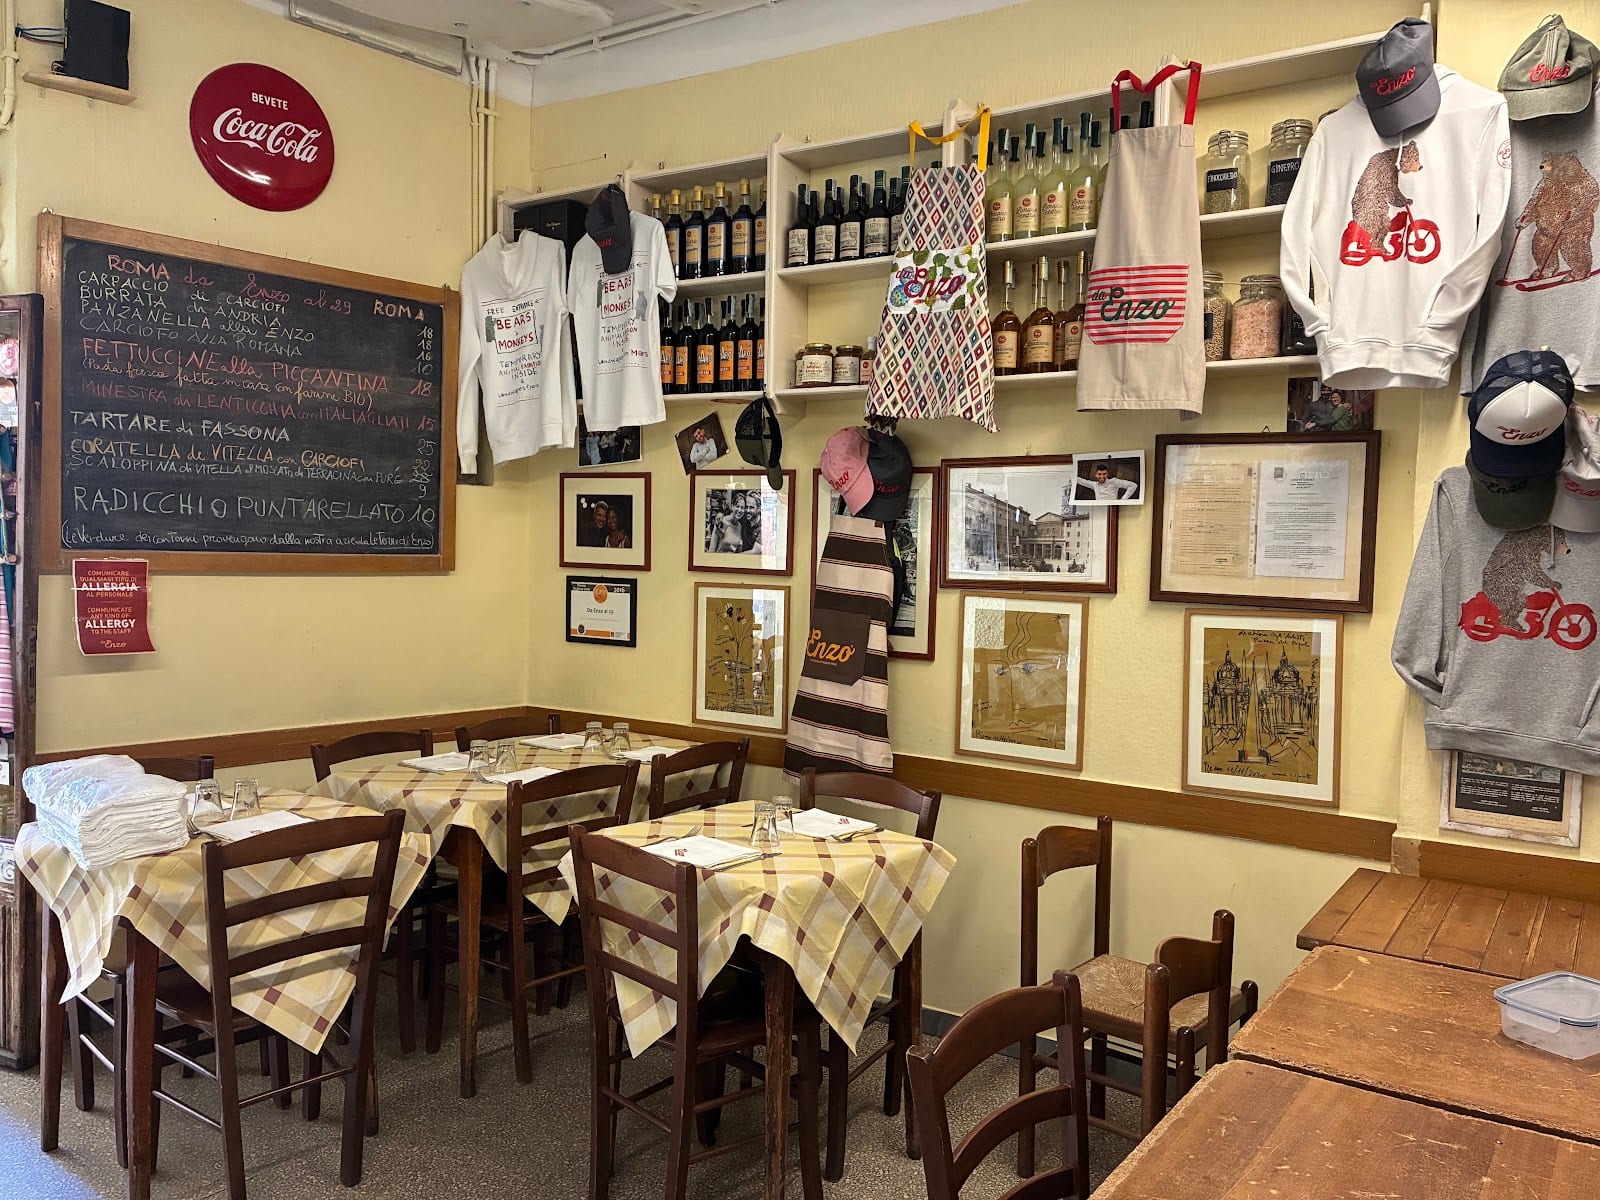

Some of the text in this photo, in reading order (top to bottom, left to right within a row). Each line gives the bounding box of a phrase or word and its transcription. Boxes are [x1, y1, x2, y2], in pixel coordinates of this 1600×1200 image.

[1377, 66, 1416, 96] Enzo
[1529, 63, 1571, 83] Enzo
[251, 92, 289, 111] BEVETE
[1271, 160, 1300, 174] GINEPRO
[108, 254, 170, 281] ROMA
[184, 266, 214, 286] da
[240, 273, 290, 302] Enzo
[329, 299, 352, 315] 29
[373, 299, 425, 321] ROMA
[604, 276, 632, 294] BEARS
[895, 266, 967, 298] da Enzo
[78, 270, 169, 292] CARPACCIO
[226, 295, 285, 315] CARCIOFI
[417, 326, 434, 339] 18
[80, 286, 168, 309] BURRATA
[214, 306, 281, 328] ANDRIA
[417, 339, 432, 350] 18
[1091, 286, 1176, 321] da Enzo
[81, 300, 432, 361] PANZANELLA alla ENZO 16
[496, 312, 532, 330] BEARS
[80, 315, 433, 376] CARCIOFO ALLA ROMANA 10
[498, 332, 534, 351] MONKEYS
[83, 337, 433, 397] FETTUCCINE alla PICCANTINA 18
[175, 366, 219, 388] fatta
[82, 380, 168, 402] MINESTRA
[197, 393, 297, 419] LENTICCHIA
[417, 415, 437, 431] 15
[69, 410, 436, 456] TARTARE di FASSONA 25
[1502, 428, 1548, 441] Enzo
[70, 454, 178, 473] SCALOPPINA
[195, 463, 242, 475] VITELLA
[304, 467, 357, 481] TERRACINA
[212, 443, 274, 462] VITELLA
[301, 450, 365, 472] CARCIOFI
[73, 486, 227, 519] RADICCHIO
[237, 495, 405, 523] PUNTARELLATO
[269, 532, 301, 545] dalla
[81, 582, 139, 591] ALLERGIA
[85, 619, 136, 629] ALLERGY
[806, 627, 855, 663] Enzo
